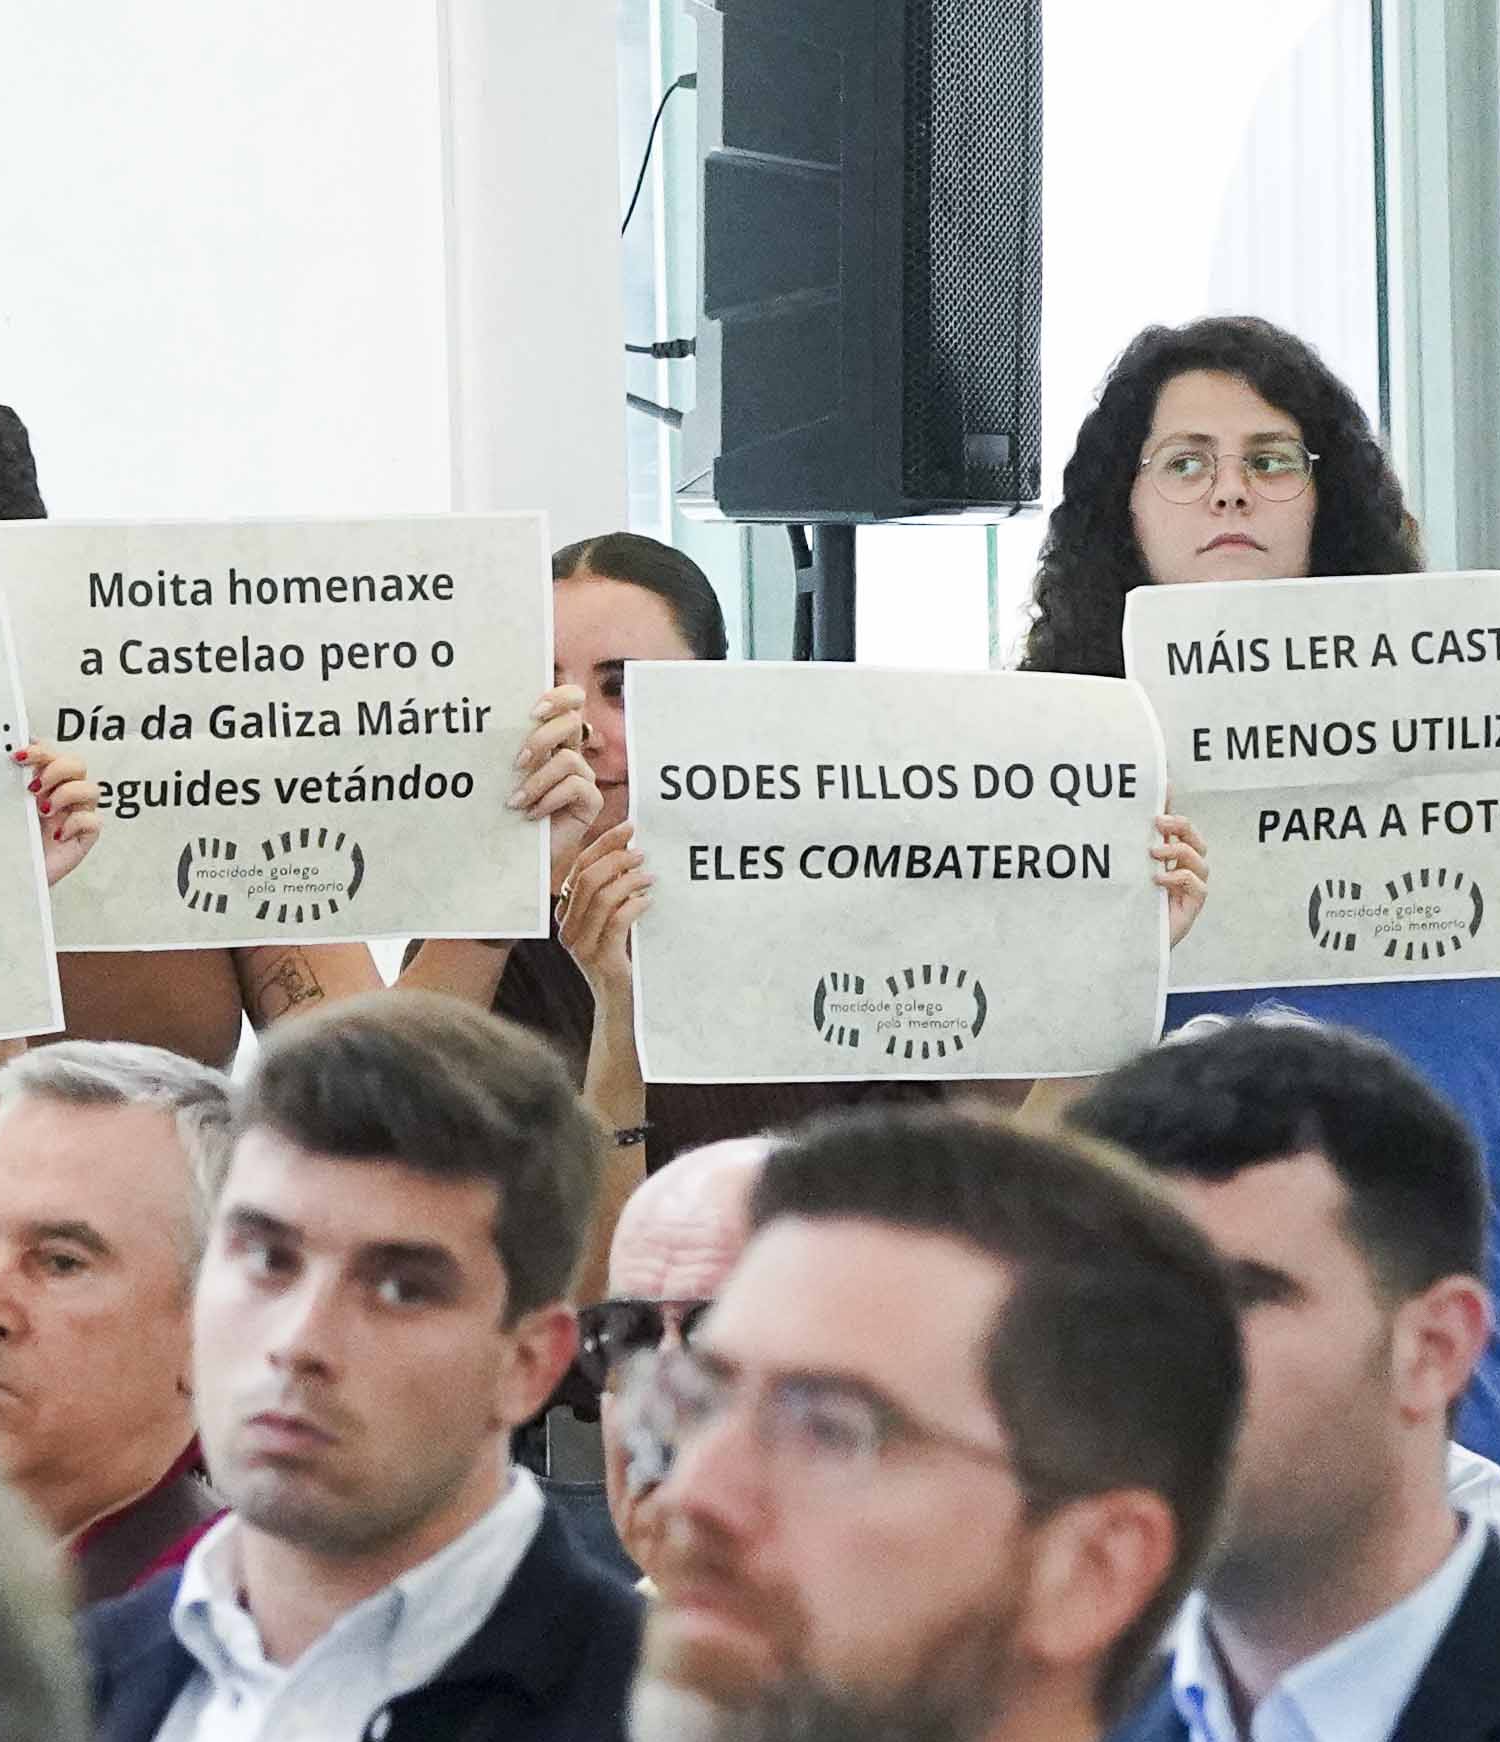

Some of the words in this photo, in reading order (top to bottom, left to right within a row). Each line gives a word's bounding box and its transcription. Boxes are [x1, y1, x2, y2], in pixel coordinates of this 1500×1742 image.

[90, 570, 212, 607] Moita
[229, 568, 453, 605] homenaxe
[80, 648, 103, 675] a
[120, 635, 304, 674] Castelao
[321, 642, 417, 681] pero
[432, 641, 454, 667] o
[1167, 630, 1269, 675] MÁIS
[1286, 635, 1358, 670] LER
[1371, 633, 1397, 667] A
[57, 705, 125, 742] Día
[141, 704, 192, 740] da
[209, 702, 340, 739] Galiza
[358, 697, 491, 736] Mártir
[1193, 728, 1211, 761] E
[1227, 721, 1376, 760] MENOS
[97, 769, 260, 819] eguides
[274, 764, 473, 804] vetándoo
[661, 765, 800, 800] SODES
[817, 765, 958, 799] FILLOS
[974, 764, 1034, 799] DO
[1050, 764, 1136, 806] QUE
[1259, 805, 1367, 843] PARA
[1380, 804, 1407, 837] A
[690, 845, 785, 880] ELES
[800, 844, 1109, 879] COMBATERON
